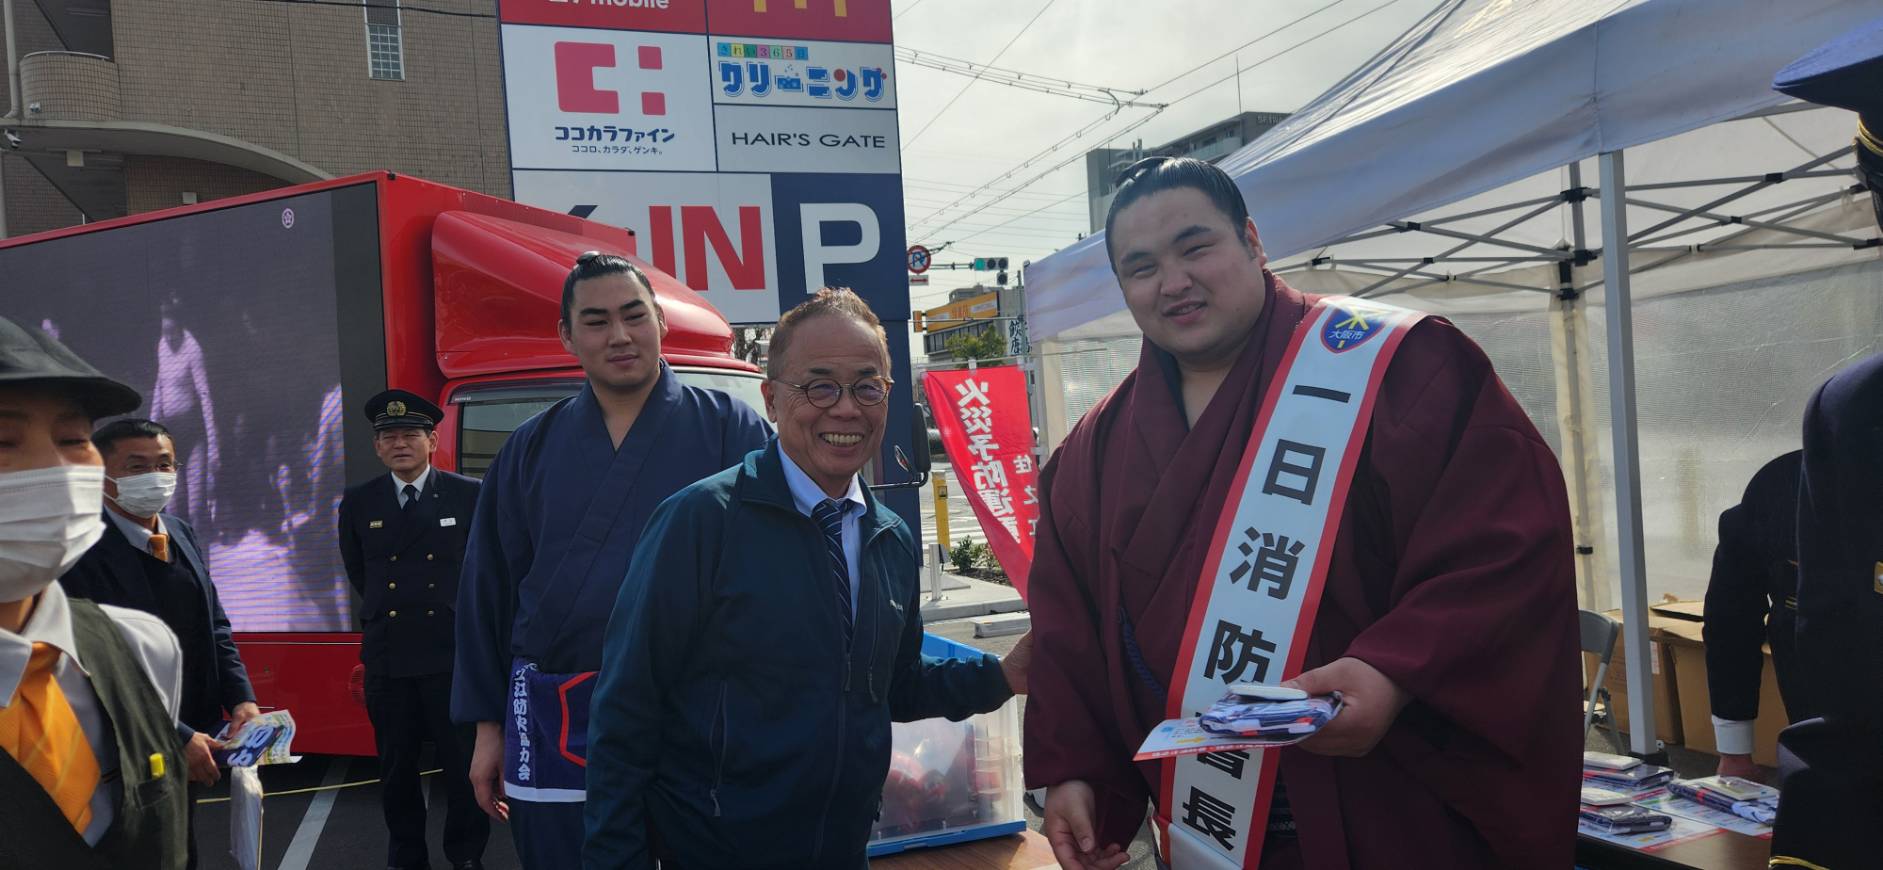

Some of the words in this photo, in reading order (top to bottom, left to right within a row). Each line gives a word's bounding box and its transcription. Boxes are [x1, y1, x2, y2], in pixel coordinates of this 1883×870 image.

[718, 61, 888, 101] クリーニング
[554, 125, 675, 143] ココカラファイン
[731, 132, 811, 147] HAIR'S
[819, 134, 886, 148] GATE
[648, 205, 766, 291] IN
[800, 202, 880, 294] P
